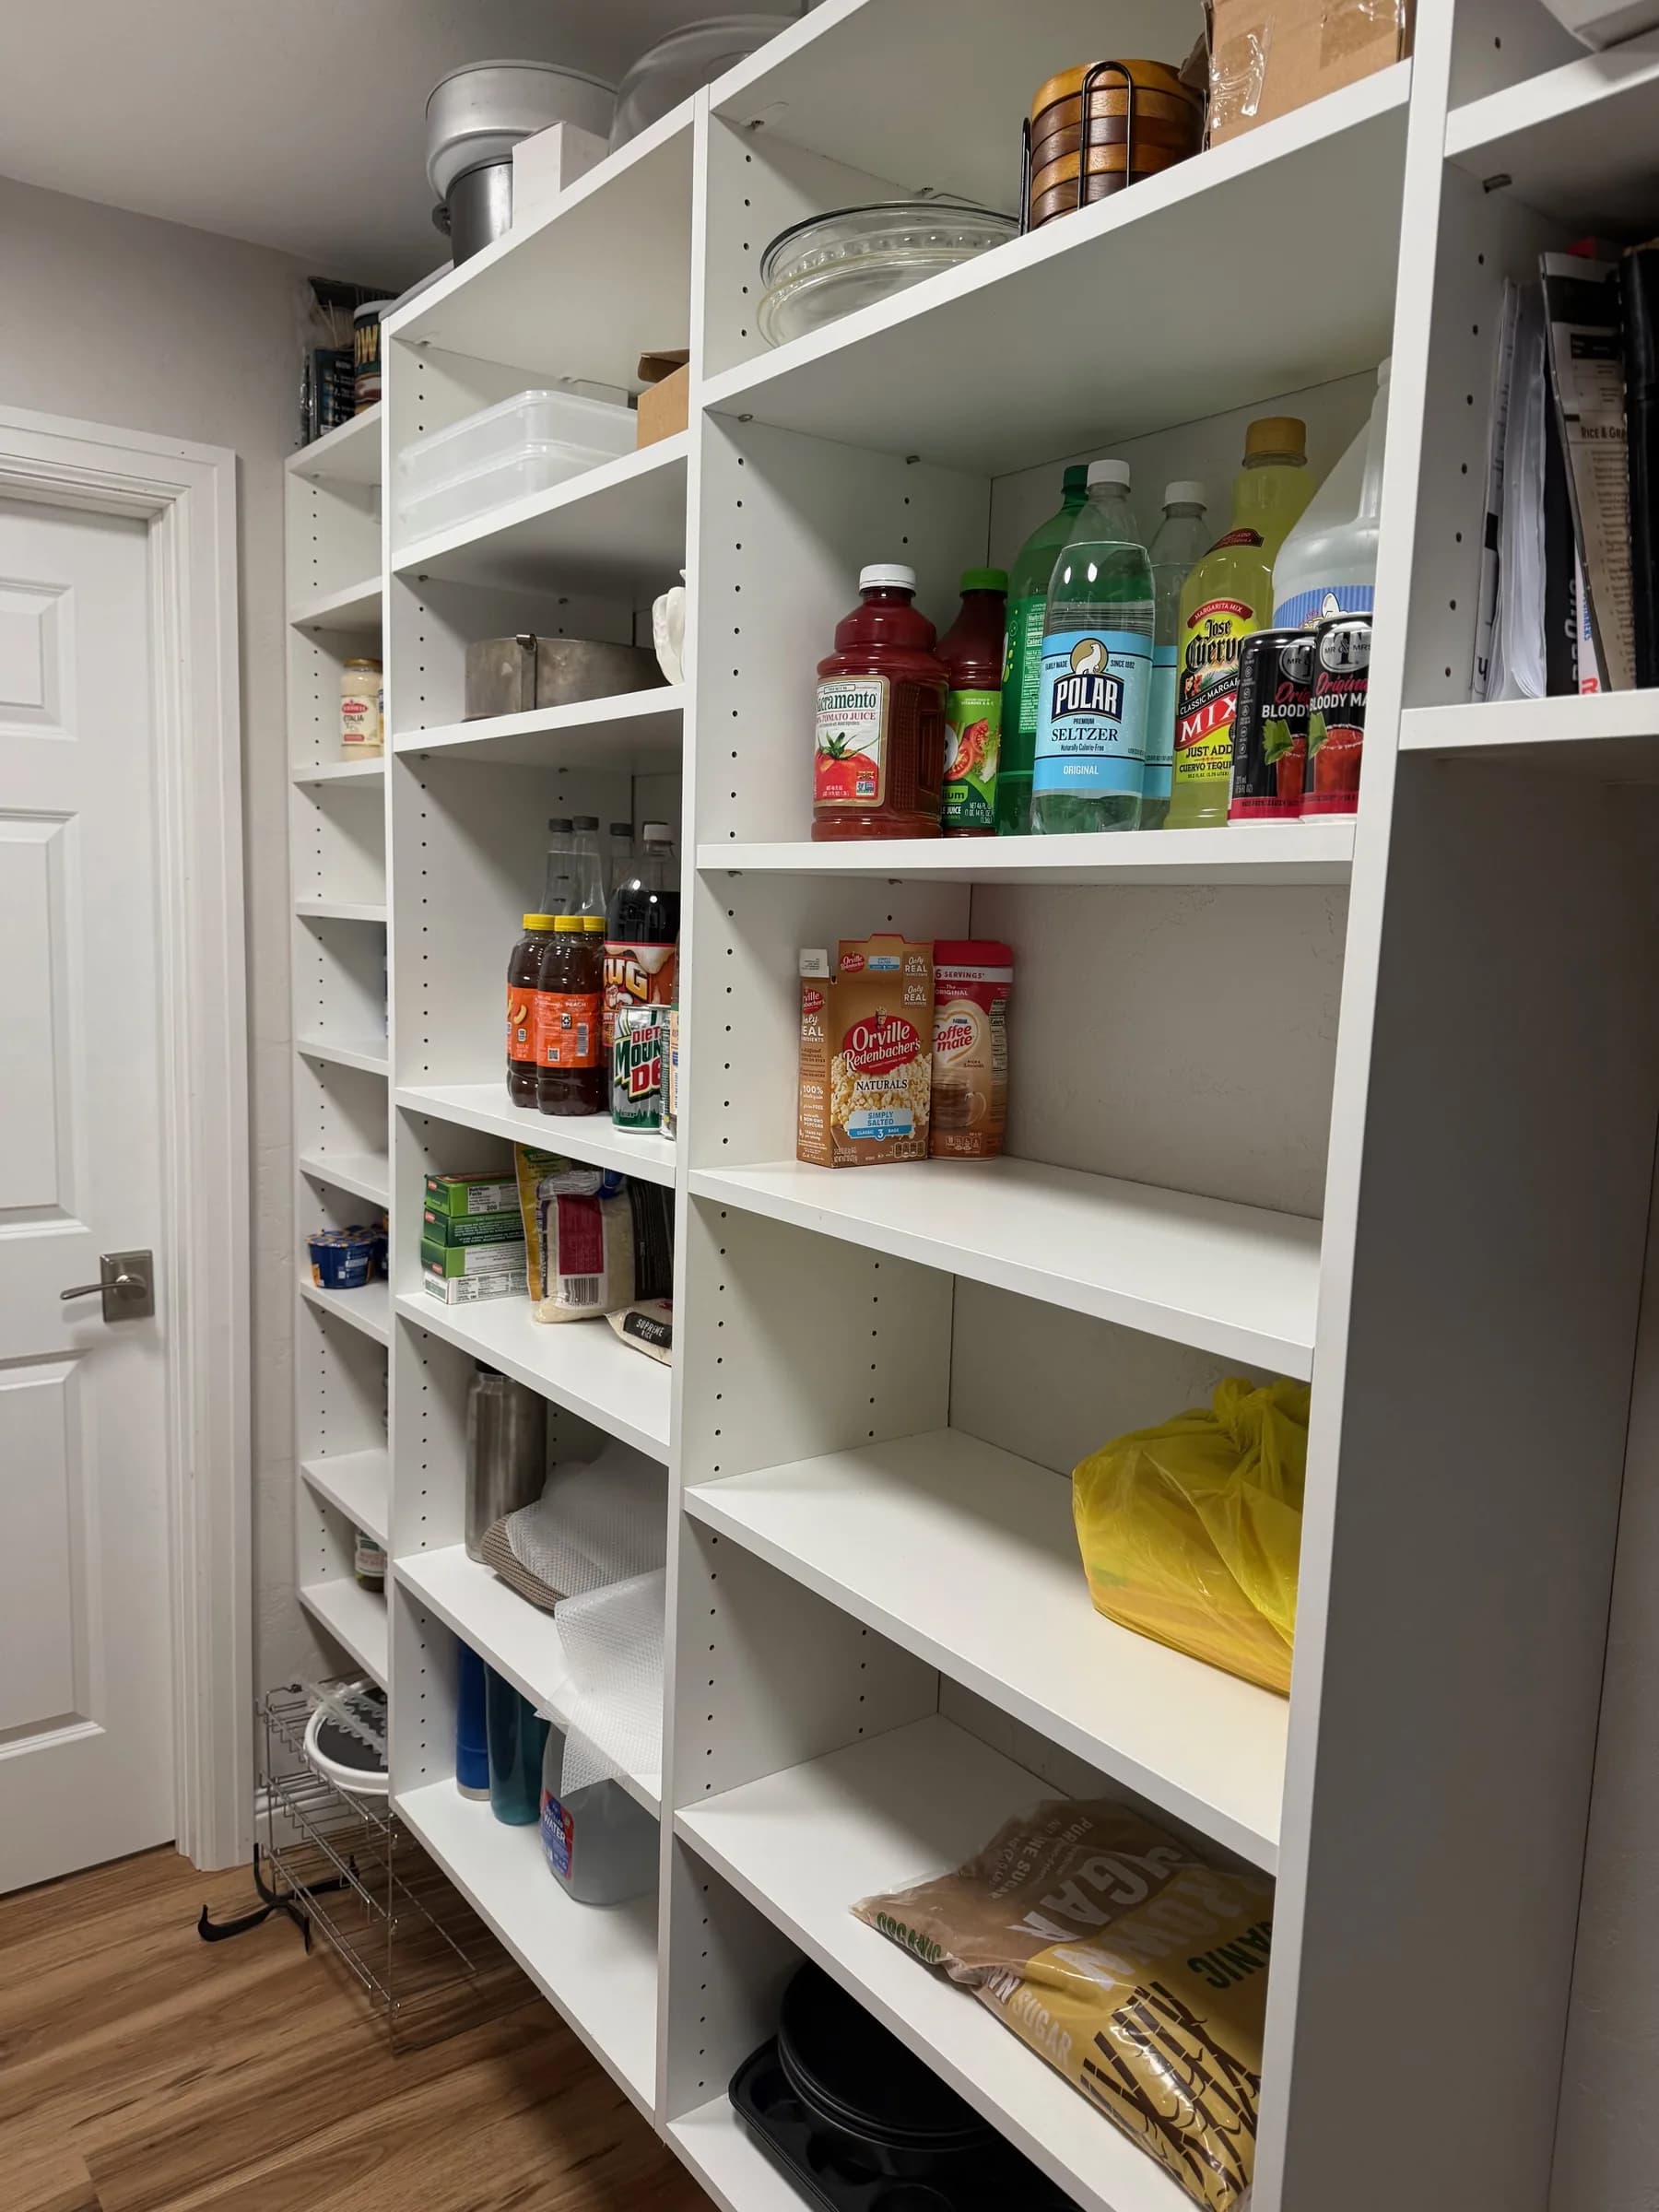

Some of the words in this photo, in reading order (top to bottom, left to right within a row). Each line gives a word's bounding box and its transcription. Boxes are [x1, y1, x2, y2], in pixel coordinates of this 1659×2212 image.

[1194, 602, 1228, 620] MARGARITA
[1229, 604, 1243, 613] MIX
[1205, 618, 1232, 638] Jose
[1110, 659, 1124, 668] SINCE
[1055, 677, 1119, 715] POLAR
[1310, 693, 1347, 712] BLOODY
[1180, 694, 1206, 715] CLASSIC
[1262, 703, 1310, 718] BLOOD
[850, 712, 877, 721] JUICE
[1180, 696, 1237, 743] MIX
[1051, 727, 1119, 742] SELTZER
[1186, 746, 1210, 758] JUST
[1210, 744, 1233, 756] ADD
[1063, 765, 1100, 775] ORIGINAL
[1179, 762, 1206, 773] CUERVO
[908, 956, 924, 965] Only
[904, 965, 928, 973] REAL
[604, 958, 648, 1002] UG
[907, 984, 924, 994] Only
[935, 988, 969, 996] ORIGINAL
[904, 994, 927, 1002] REAL
[631, 1025, 661, 1044] DIET
[803, 1026, 824, 1037] EAL
[853, 1020, 911, 1052] Orville
[936, 1034, 972, 1053] mate
[842, 1038, 922, 1071] Redenbacher's
[856, 1079, 907, 1091] NATURALS
[867, 1111, 894, 1120] SIMPLY
[867, 1118, 894, 1127] SALTED
[877, 1128, 884, 1138] 3
[544, 1811, 566, 1844] WATER
[1062, 1816, 1094, 1843] PUR
[876, 1911, 942, 1964] ORGANIC
[1187, 1921, 1273, 1989] ANIC
[1014, 1989, 1073, 2065] SUGAR
